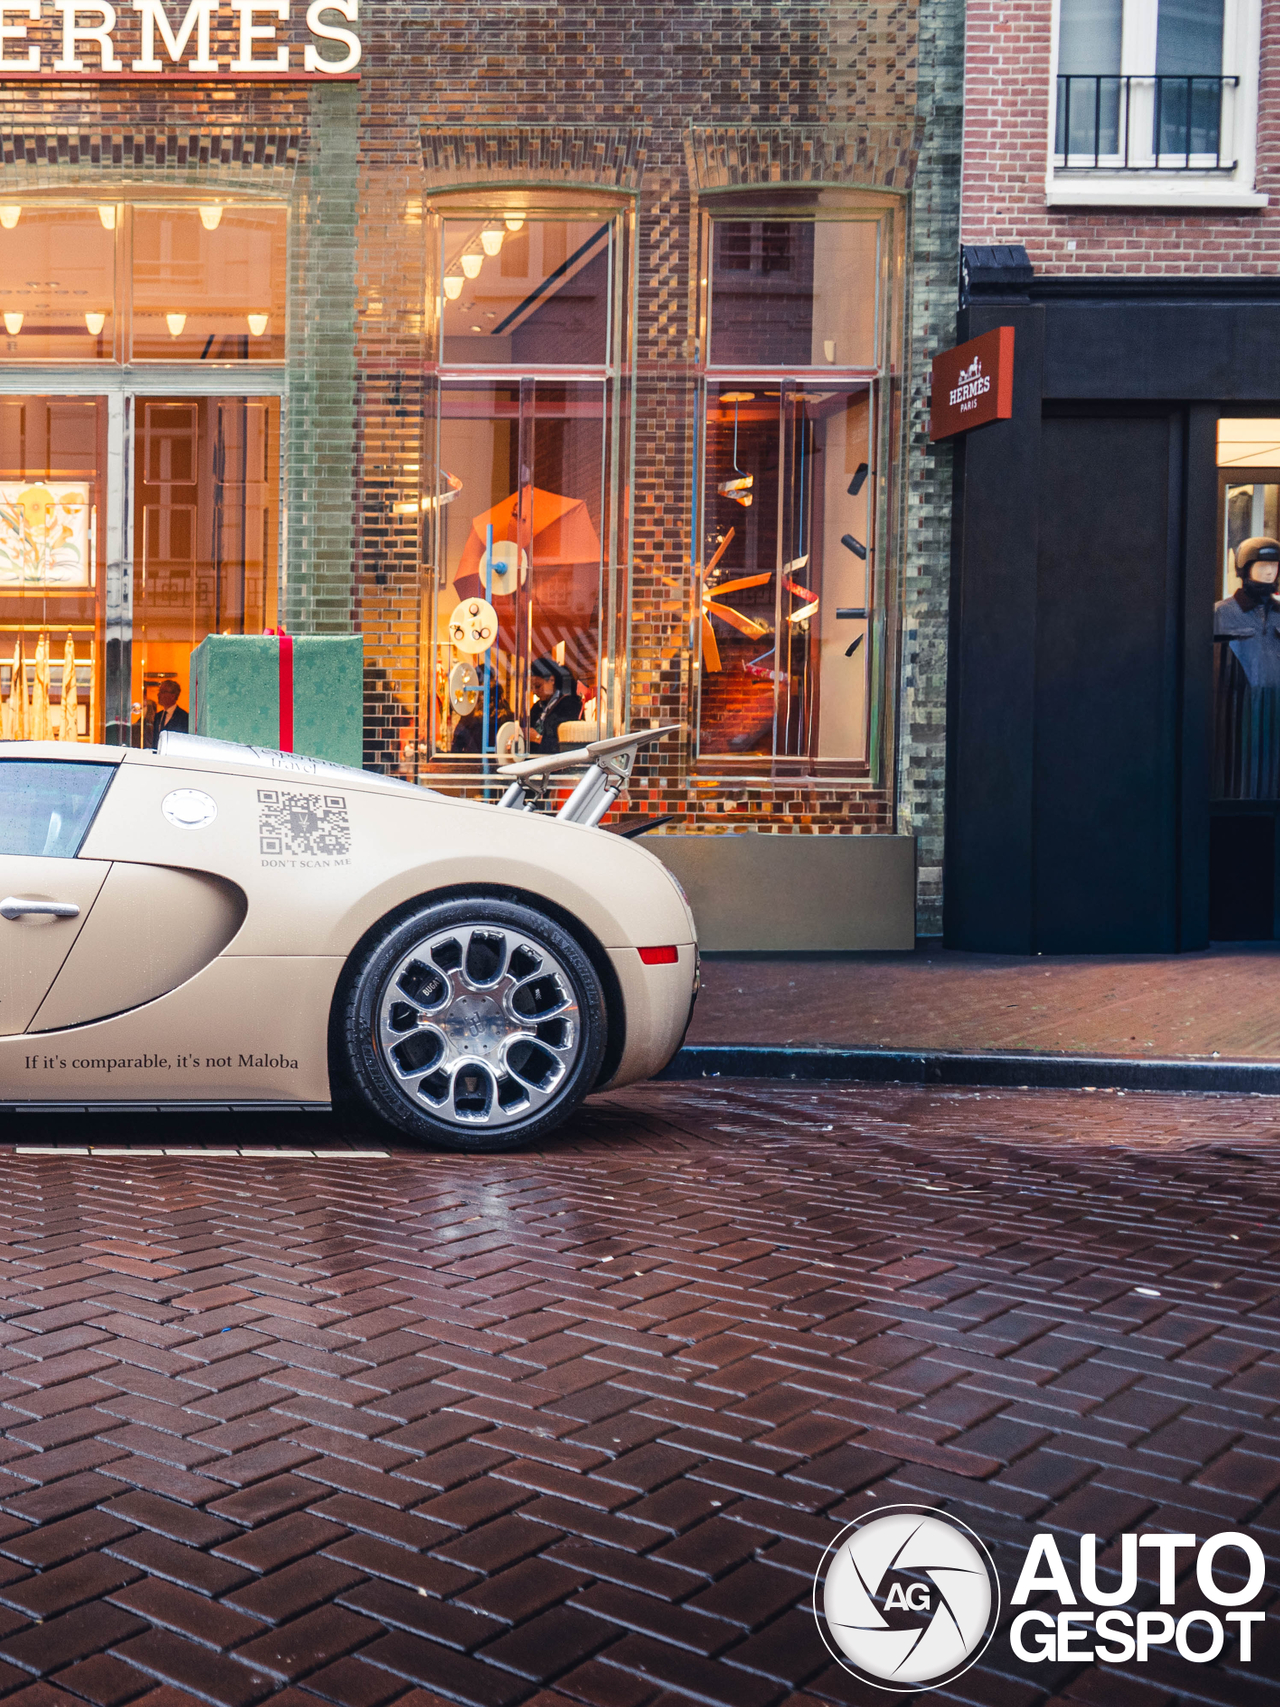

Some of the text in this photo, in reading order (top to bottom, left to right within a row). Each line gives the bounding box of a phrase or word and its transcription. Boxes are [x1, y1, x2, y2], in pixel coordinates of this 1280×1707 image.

[960, 399, 978, 413] PARIS
[261, 858, 352, 868] DON'T SCAN ME
[25, 1054, 299, 1072] If it's comparable, it's not Maloba
